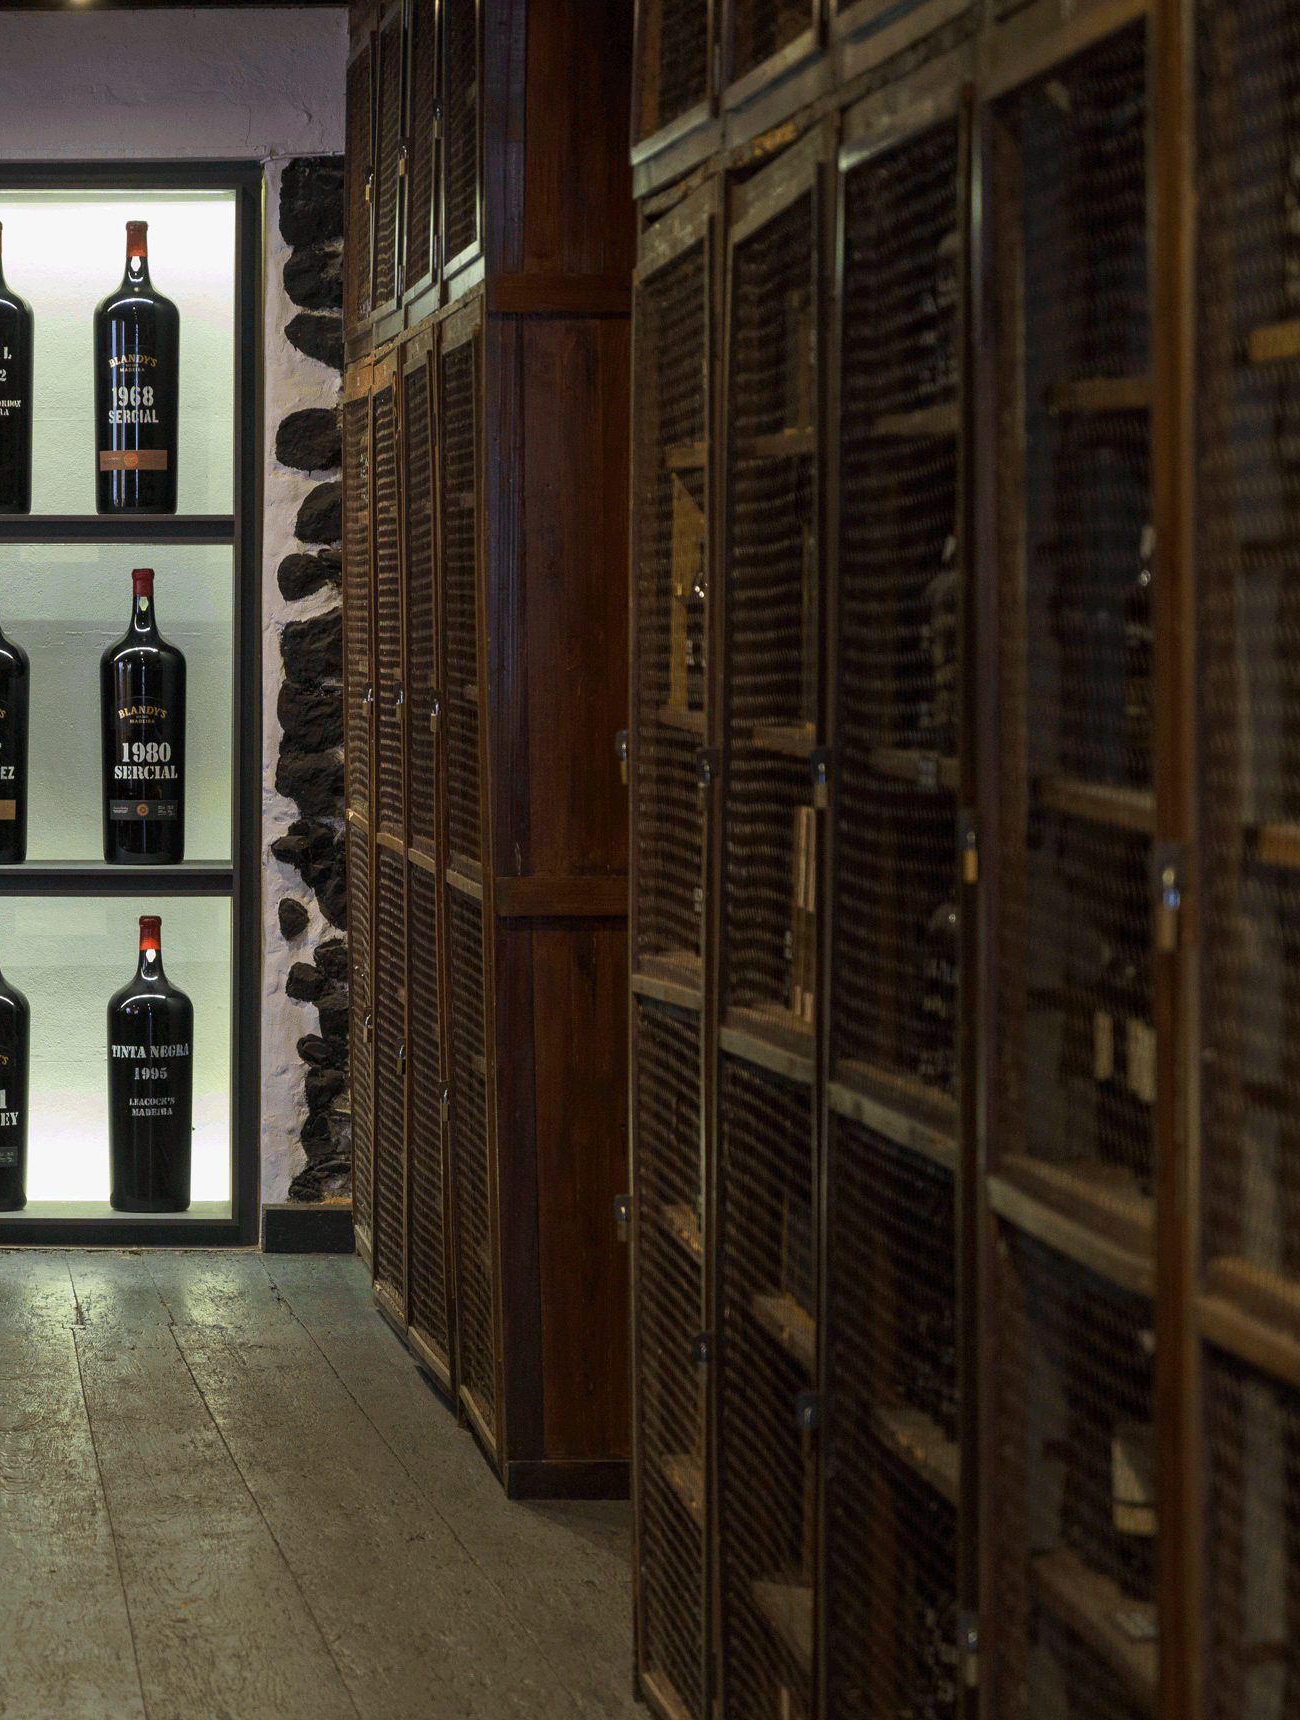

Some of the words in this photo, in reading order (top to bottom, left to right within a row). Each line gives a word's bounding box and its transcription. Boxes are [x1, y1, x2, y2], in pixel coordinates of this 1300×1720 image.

[108, 354, 157, 368] BLANDY'S
[112, 385, 154, 407] 1968
[108, 409, 159, 423] SERCIAL
[118, 705, 167, 719] BLANDY'S
[122, 742, 171, 763] 1980
[114, 765, 178, 779] SERCIAL
[112, 1044, 146, 1059] TINTA
[150, 1043, 189, 1058] NEGRA
[134, 1067, 168, 1080] 1995
[128, 1097, 176, 1106] LEACOCK'S
[131, 1107, 173, 1116] MADEIRA
